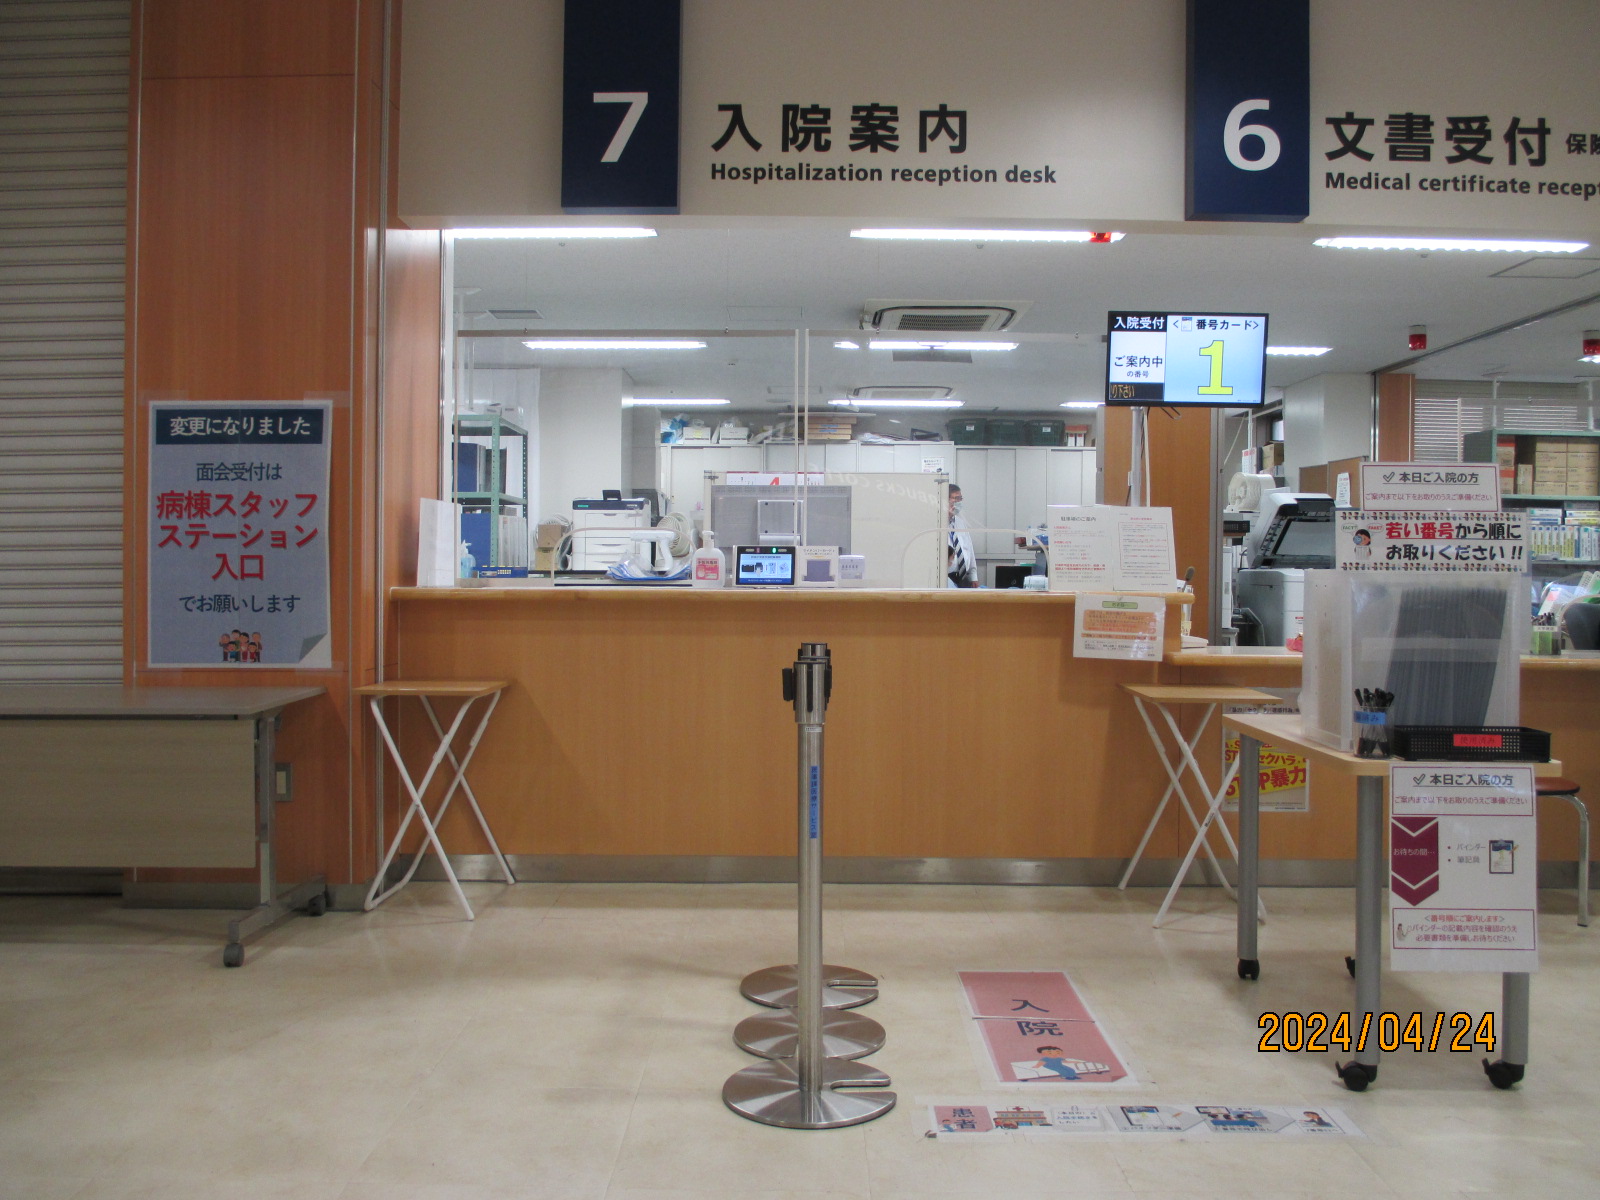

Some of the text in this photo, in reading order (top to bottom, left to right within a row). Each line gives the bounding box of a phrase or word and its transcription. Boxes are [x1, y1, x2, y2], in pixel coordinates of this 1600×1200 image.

[593, 91, 649, 163] 7
[711, 103, 968, 154] 入院案内
[1223, 99, 1282, 172] 6
[1325, 111, 1552, 168] 文書受付
[711, 163, 1057, 187] Hospitalization reception desk
[1325, 171, 1411, 191] Medical
[1418, 173, 1531, 195] certificate
[1113, 315, 1165, 330] 入院受付
[1114, 355, 1163, 369] ご案内中
[1197, 339, 1233, 395] 1
[1126, 370, 1150, 379] の番号
[170, 416, 311, 437] 変更になりました
[196, 462, 282, 482] 面会受付は
[1398, 471, 1480, 484] 本日ご入院の方
[156, 490, 319, 520] 病棟スタッフ
[157, 523, 319, 550] ステーション
[1385, 521, 1522, 540] 若い番号から順に
[212, 553, 265, 581] 入口
[179, 594, 301, 613] でお願いします
[1429, 773, 1514, 786] 本日ご入院の方
[1010, 998, 1064, 1037] 入院
[952, 1107, 978, 1130] 患者
